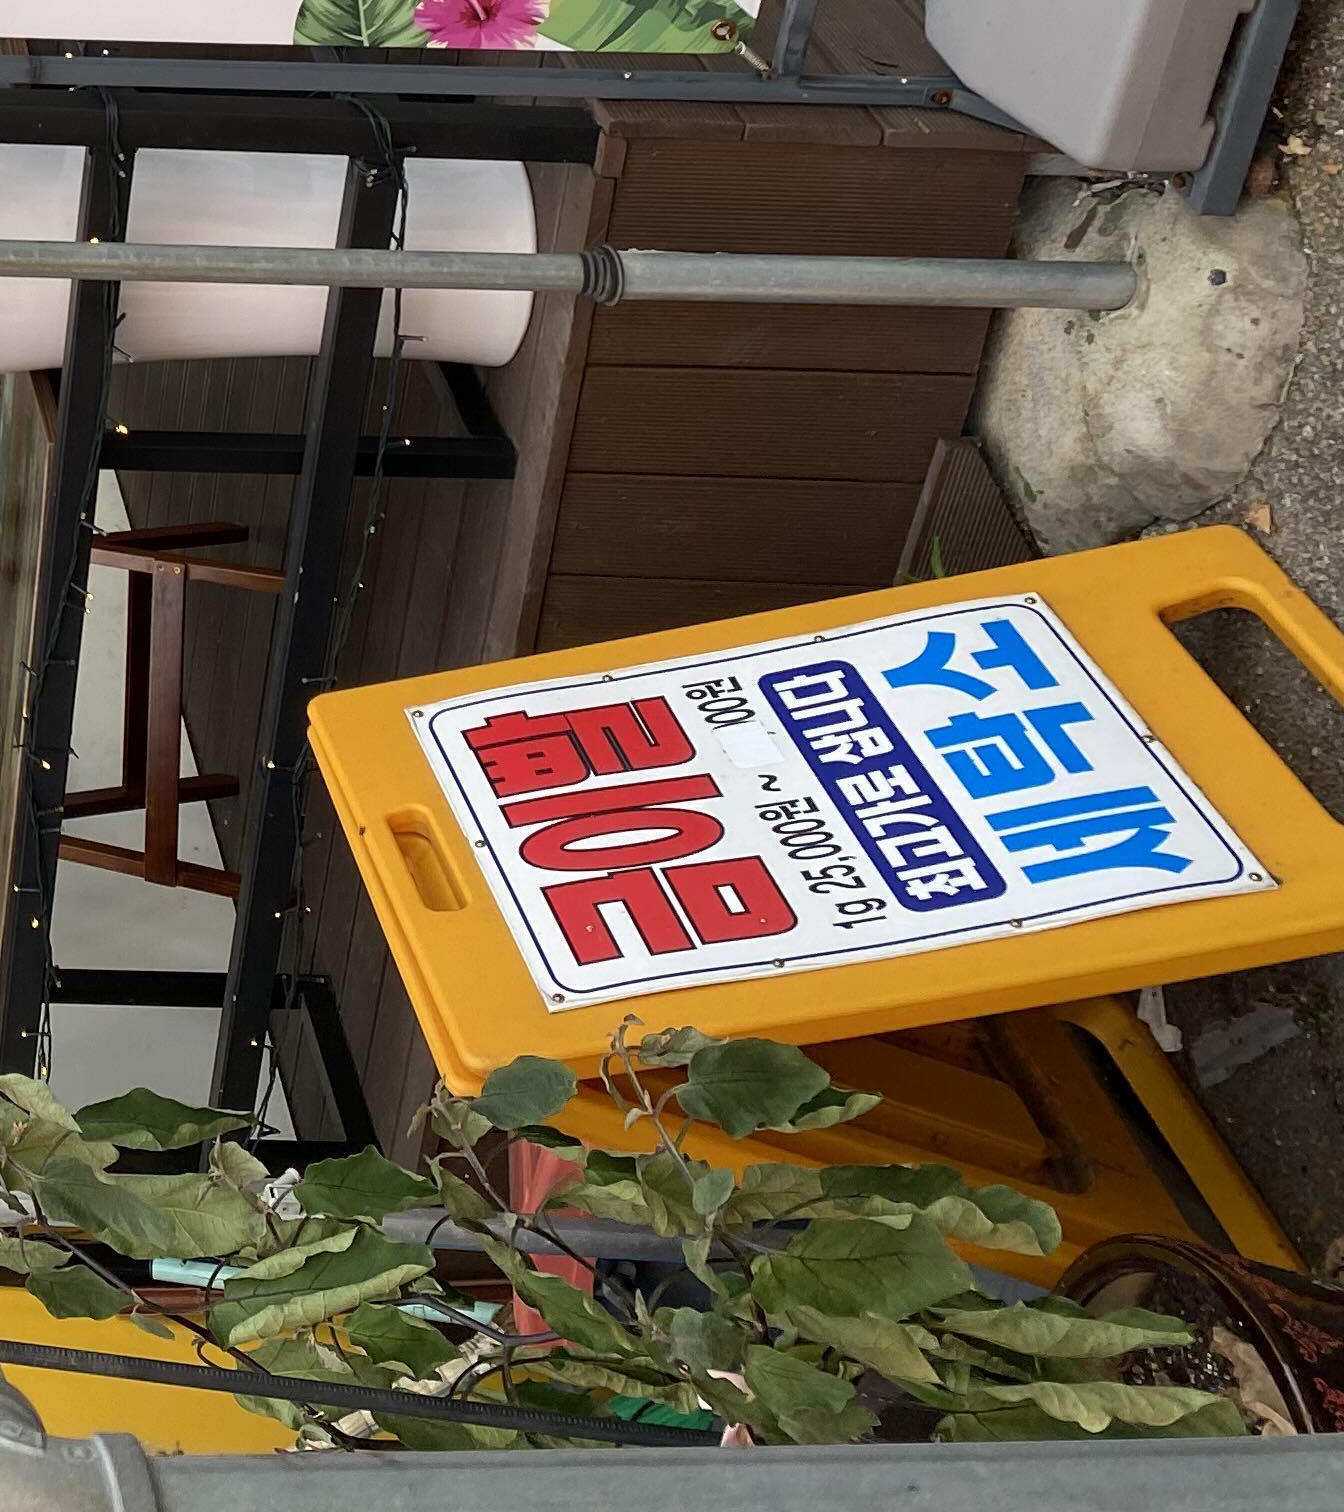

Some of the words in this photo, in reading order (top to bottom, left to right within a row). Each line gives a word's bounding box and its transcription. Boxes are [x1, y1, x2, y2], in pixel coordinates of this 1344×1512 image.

[772, 668, 896, 764] 삽니다
[879, 617, 1194, 886] 세탁소
[460, 694, 799, 966] 금이빨
[754, 796, 867, 894] 25,000원
[834, 763, 988, 901] 최고가로
[832, 897, 887, 929] 1g
